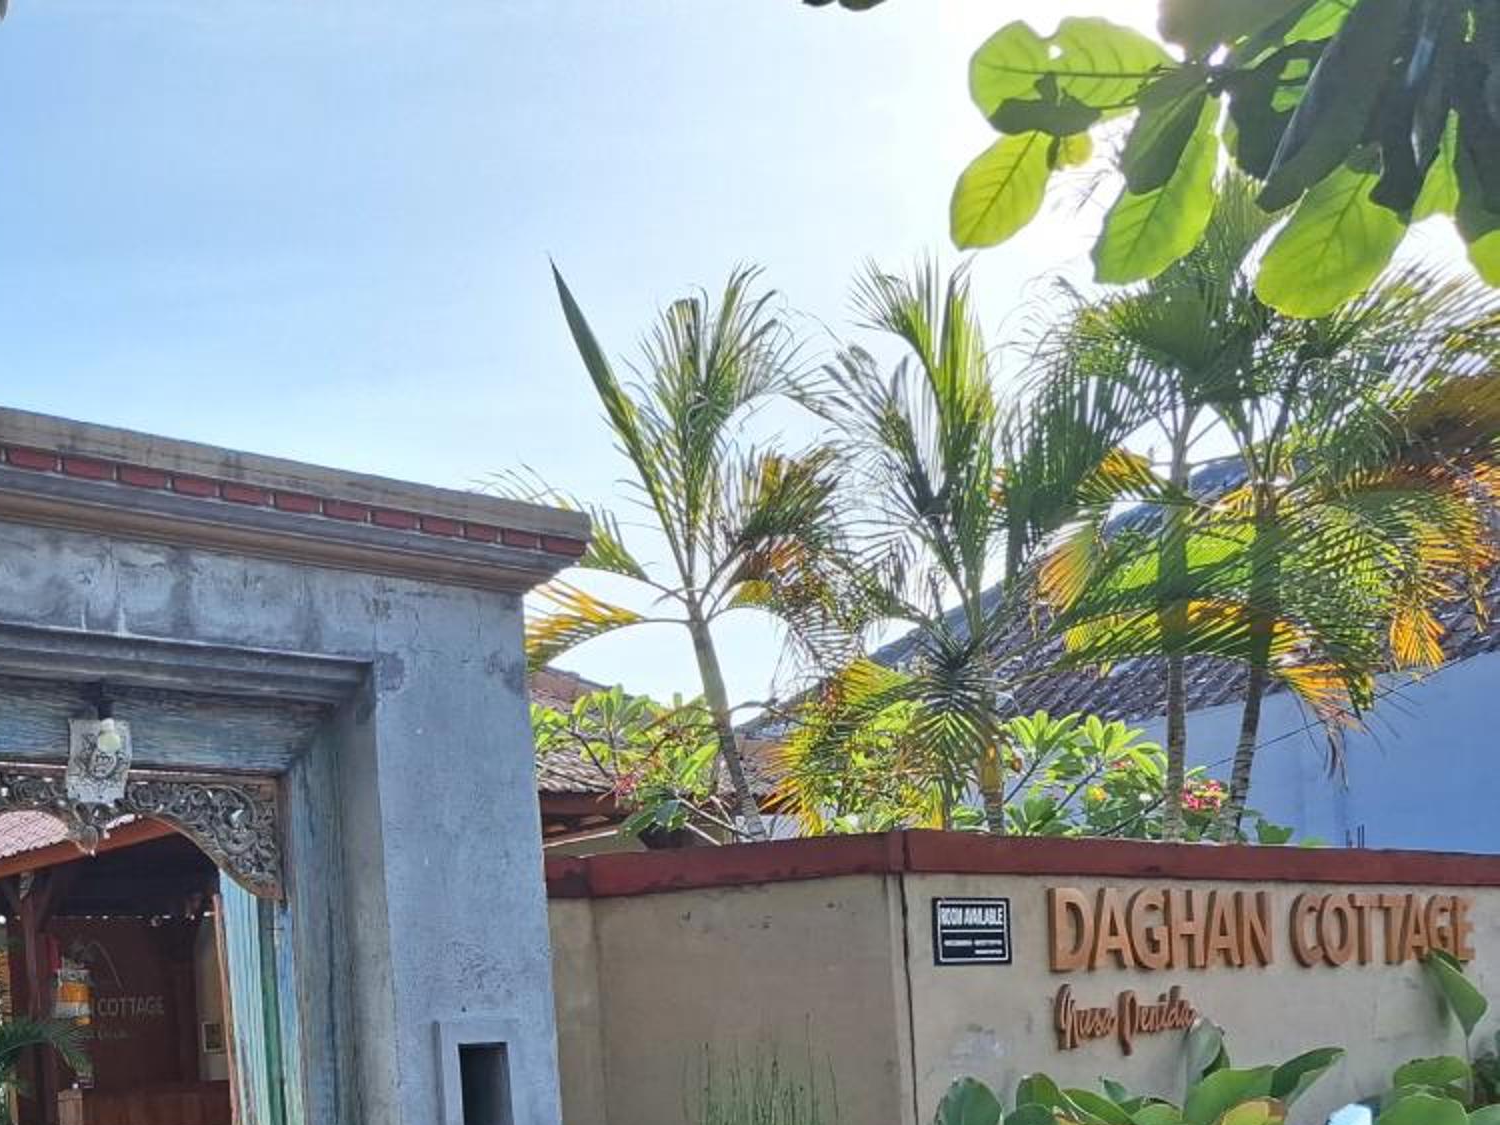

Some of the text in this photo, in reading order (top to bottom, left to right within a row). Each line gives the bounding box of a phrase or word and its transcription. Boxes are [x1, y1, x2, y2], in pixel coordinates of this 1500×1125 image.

[964, 906, 1004, 925] AVAILABLE
[1047, 887, 1476, 971] DAGHAN COTTAGE
[97, 995, 165, 1017] COTTAGE
[1054, 984, 1199, 1056] Nusa Penida
